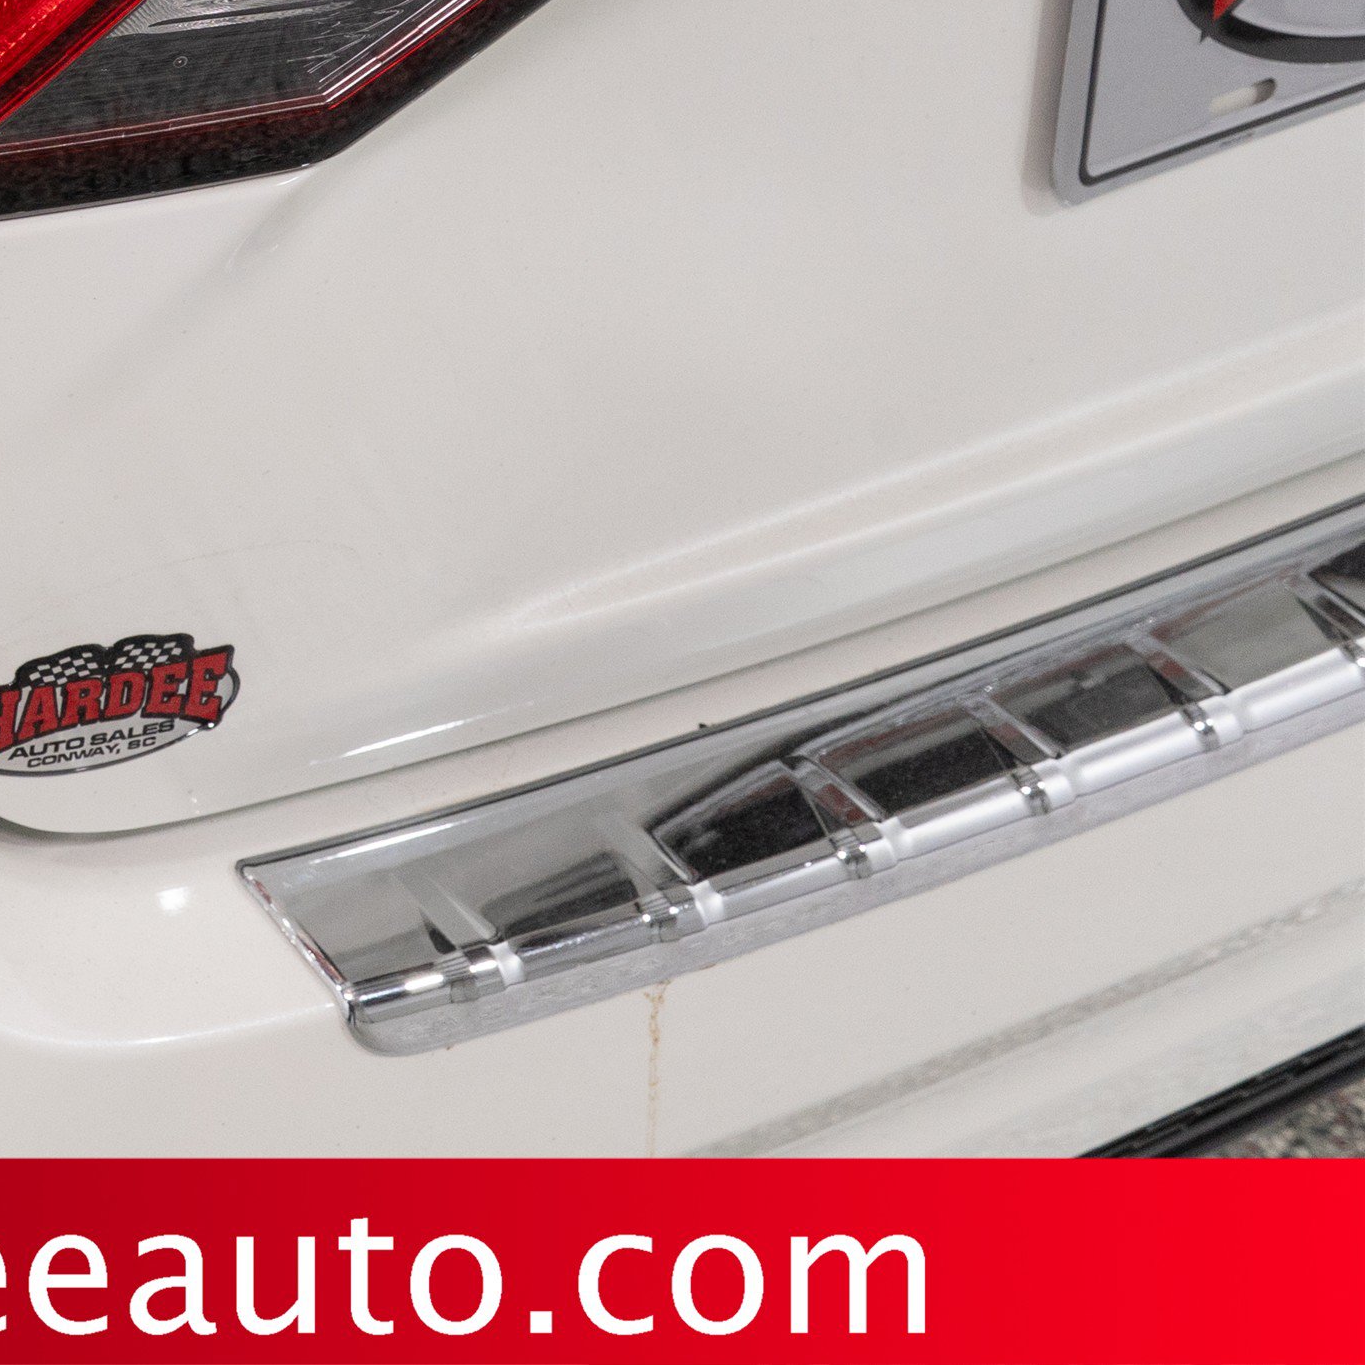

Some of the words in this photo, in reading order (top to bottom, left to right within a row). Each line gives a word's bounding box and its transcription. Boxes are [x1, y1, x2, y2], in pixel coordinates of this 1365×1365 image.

[8, 736, 85, 761] AUTO
[90, 720, 175, 746] SALES
[27, 745, 121, 768] CONWAY,
[127, 736, 157, 751] SC
